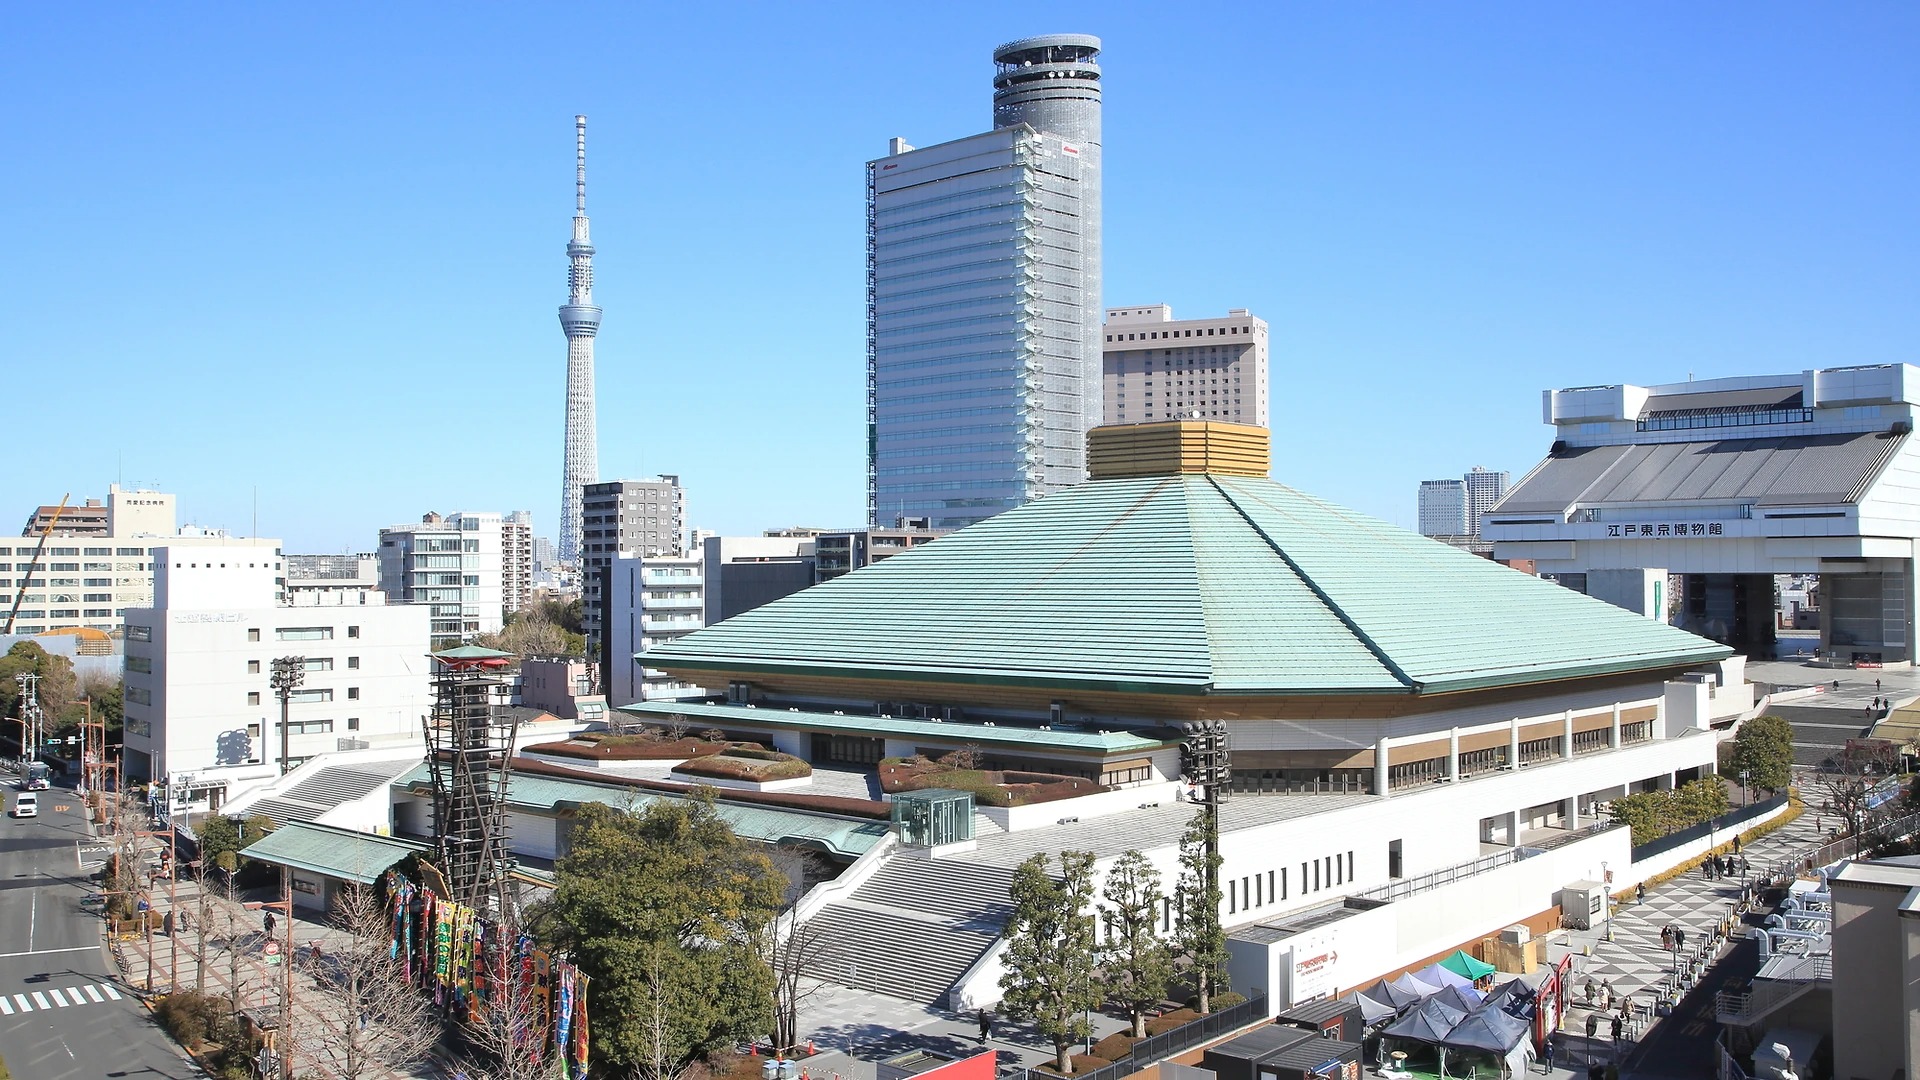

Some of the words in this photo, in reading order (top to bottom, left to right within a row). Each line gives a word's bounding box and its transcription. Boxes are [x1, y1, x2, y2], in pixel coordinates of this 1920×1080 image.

[1608, 523, 1722, 537] 江戸東京博物館
